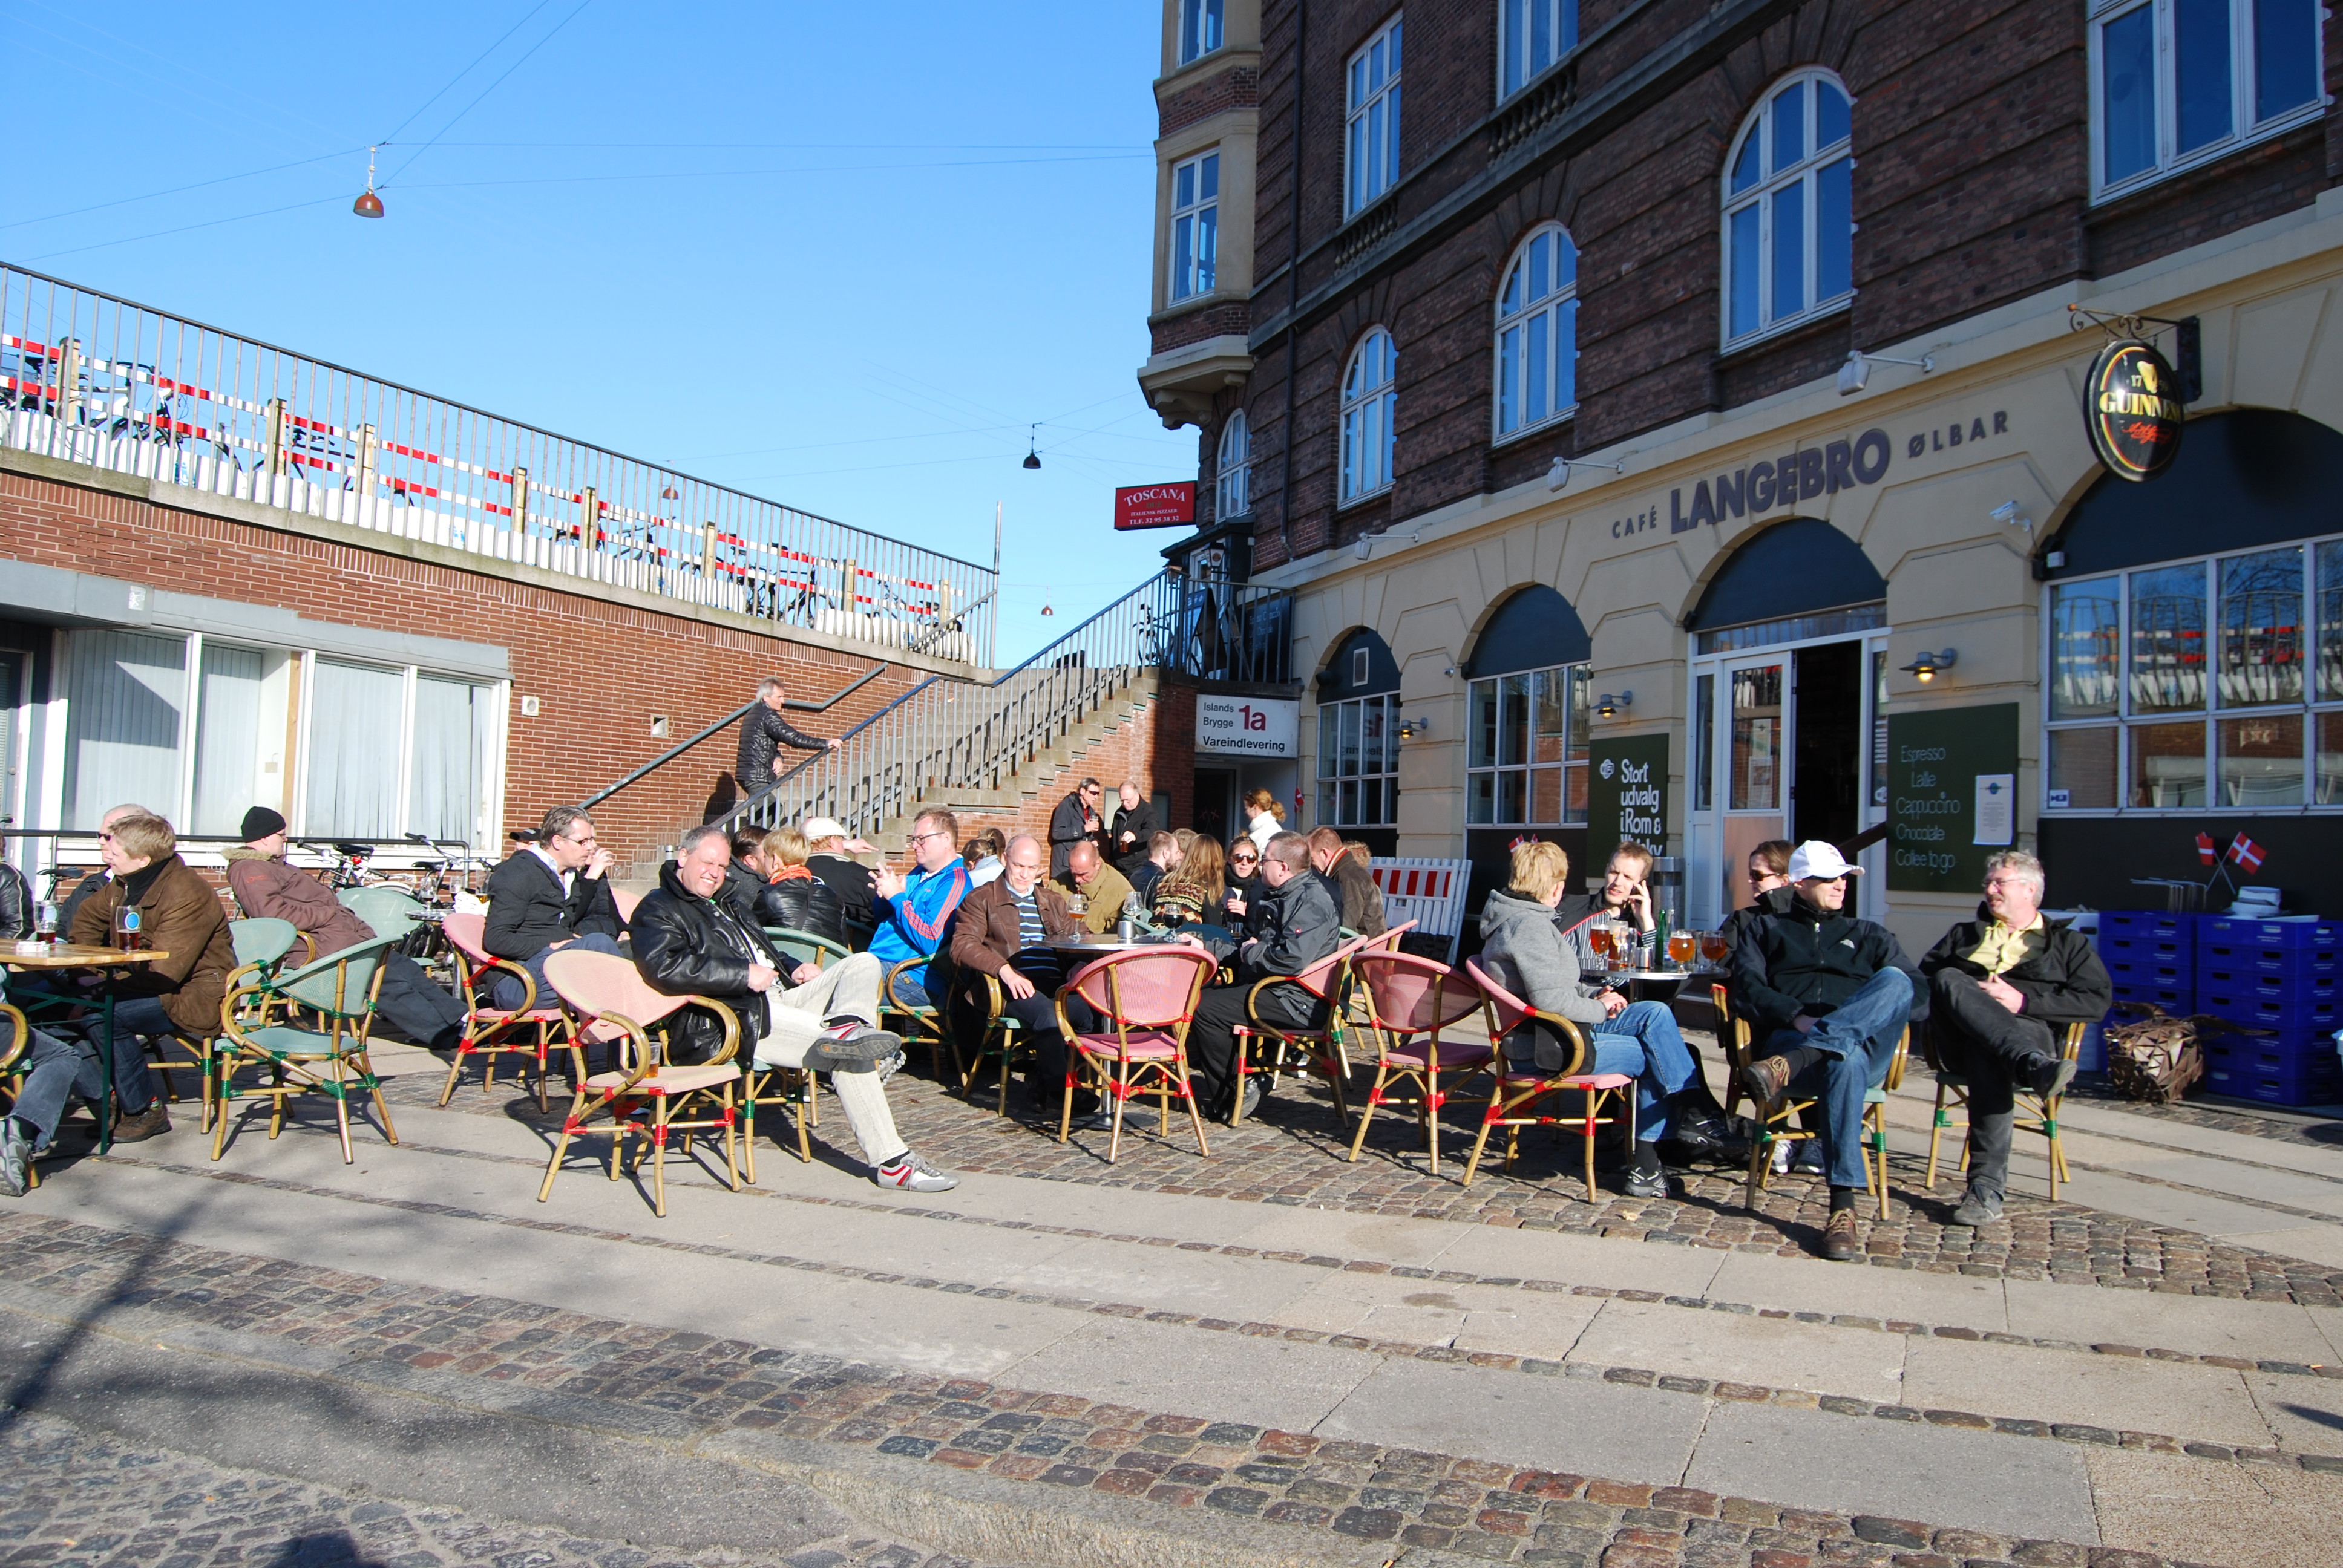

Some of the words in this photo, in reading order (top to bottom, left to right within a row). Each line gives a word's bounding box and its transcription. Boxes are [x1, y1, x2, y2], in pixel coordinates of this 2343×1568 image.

[1612, 505, 1657, 539] CAFÉ
[1671, 428, 1892, 535] LANGEBRO
[1907, 410, 2009, 459] ØLBAR
[1124, 488, 1185, 506] TOSCANA
[1204, 702, 1234, 713] Islands
[1203, 717, 1234, 728] Brygge
[1239, 705, 1267, 731] 1a
[1202, 736, 1285, 753] Vareindlevering
[1901, 745, 1947, 768] Espresso
[1621, 759, 1649, 783] Stort
[1911, 771, 1936, 787] Latte
[1620, 784, 1660, 814] udvalg
[1896, 791, 1961, 820] Cappuccino
[1620, 811, 1624, 832] i
[1625, 808, 1652, 834] Rom
[1653, 817, 1662, 835] &
[1896, 823, 1945, 841] Chocolate
[1895, 849, 1927, 866] Coffee
